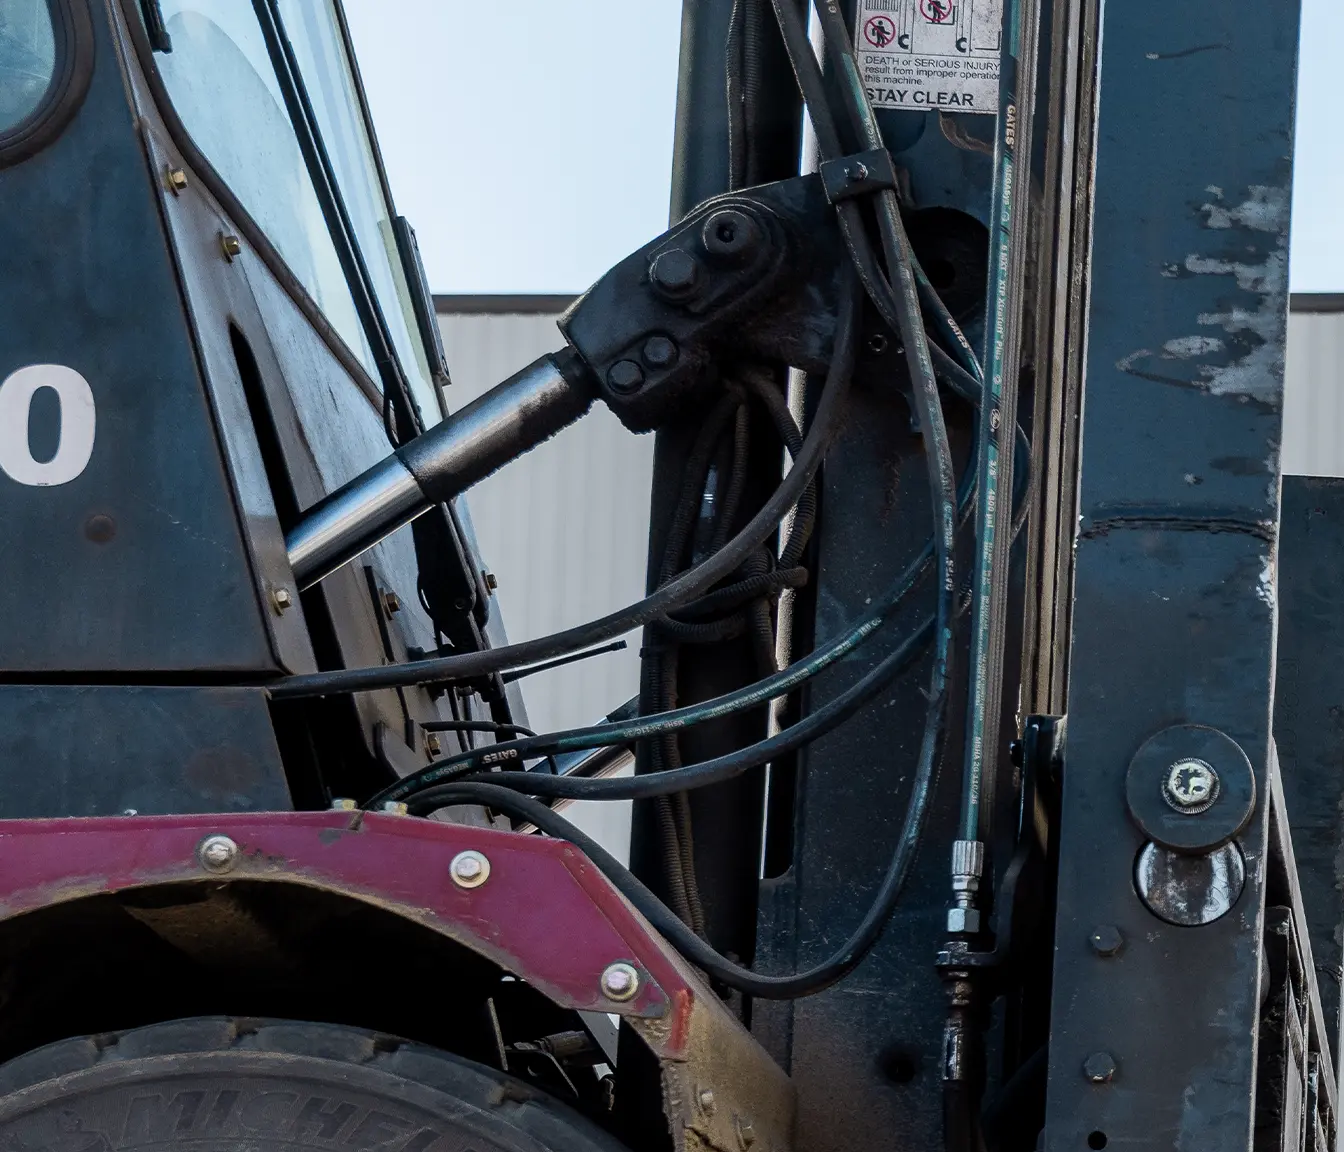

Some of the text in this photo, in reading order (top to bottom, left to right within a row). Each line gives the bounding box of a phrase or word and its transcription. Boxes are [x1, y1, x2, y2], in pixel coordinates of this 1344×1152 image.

[865, 56, 900, 67] DEATH
[914, 58, 960, 69] SERIOUS
[963, 61, 1000, 71] INJURY
[865, 66, 890, 75] result
[893, 67, 914, 76] from
[916, 69, 957, 79] improper
[865, 75, 925, 86] this machine.
[867, 88, 974, 107] STAY CLEAR
[1004, 104, 1016, 146] GATES
[987, 489, 997, 512] 4800
[485, 747, 518, 764] GATES
